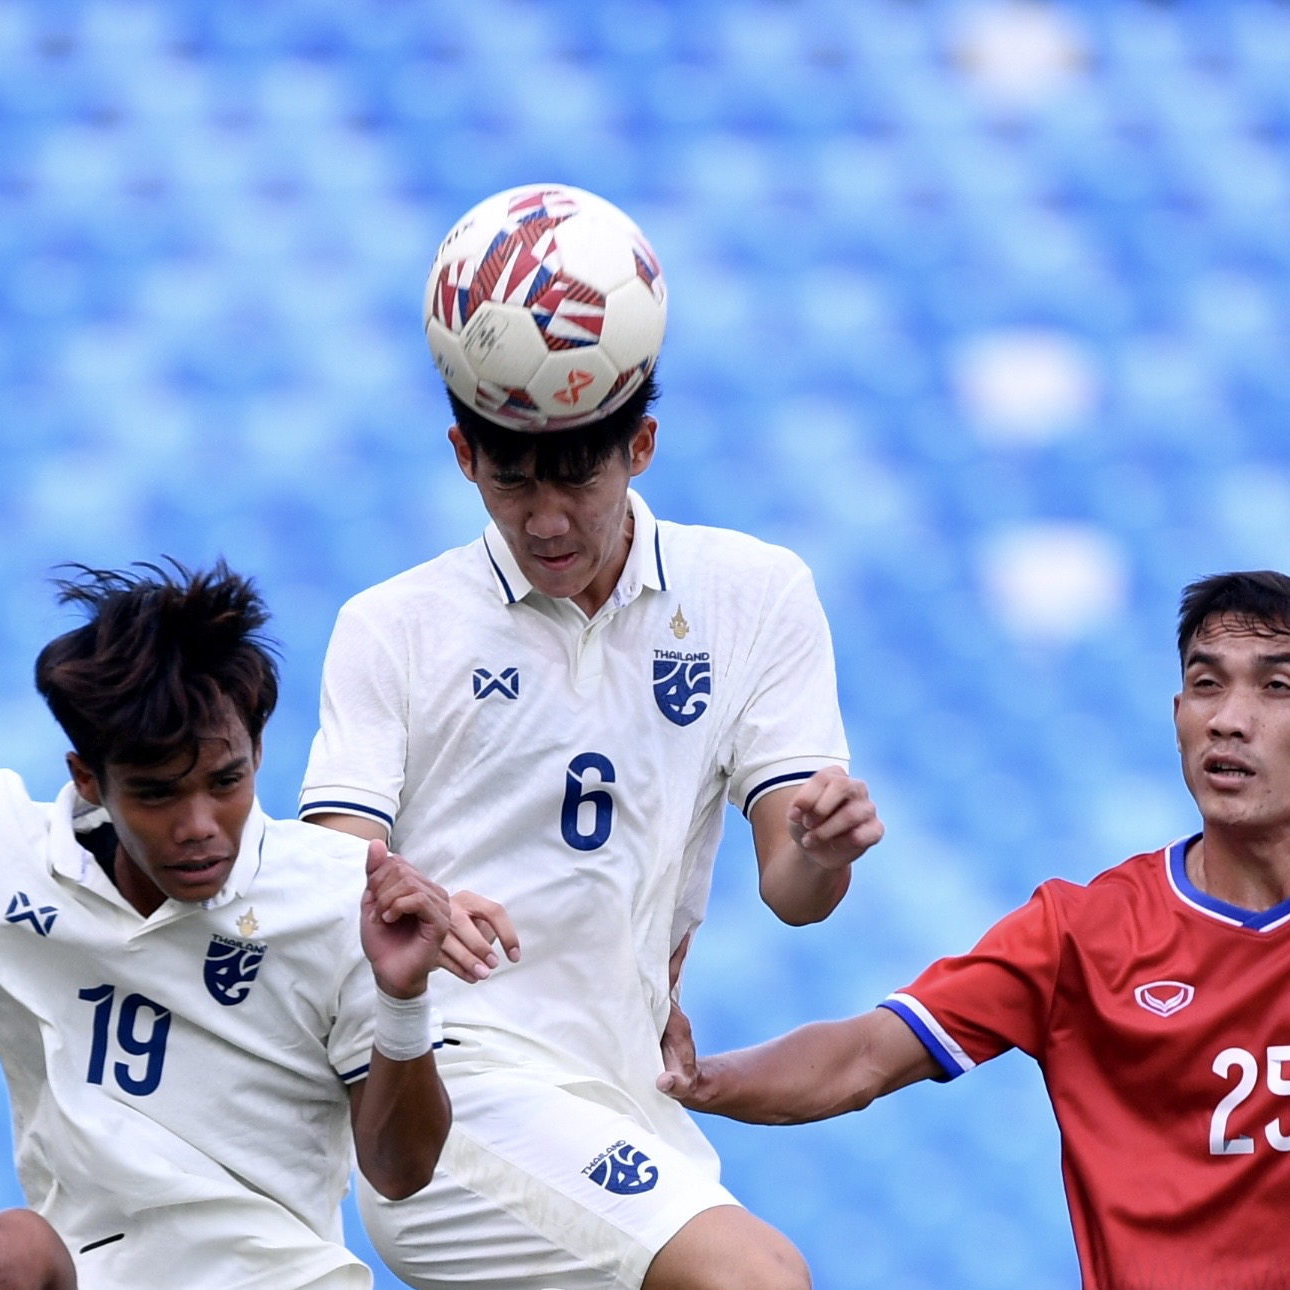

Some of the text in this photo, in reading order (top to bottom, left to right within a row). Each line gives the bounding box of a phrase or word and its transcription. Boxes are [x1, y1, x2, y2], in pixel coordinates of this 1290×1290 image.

[653, 649, 710, 661] THAILAND
[561, 752, 616, 851] 6
[78, 984, 172, 1097] 19
[580, 1139, 627, 1177] THAILAND
